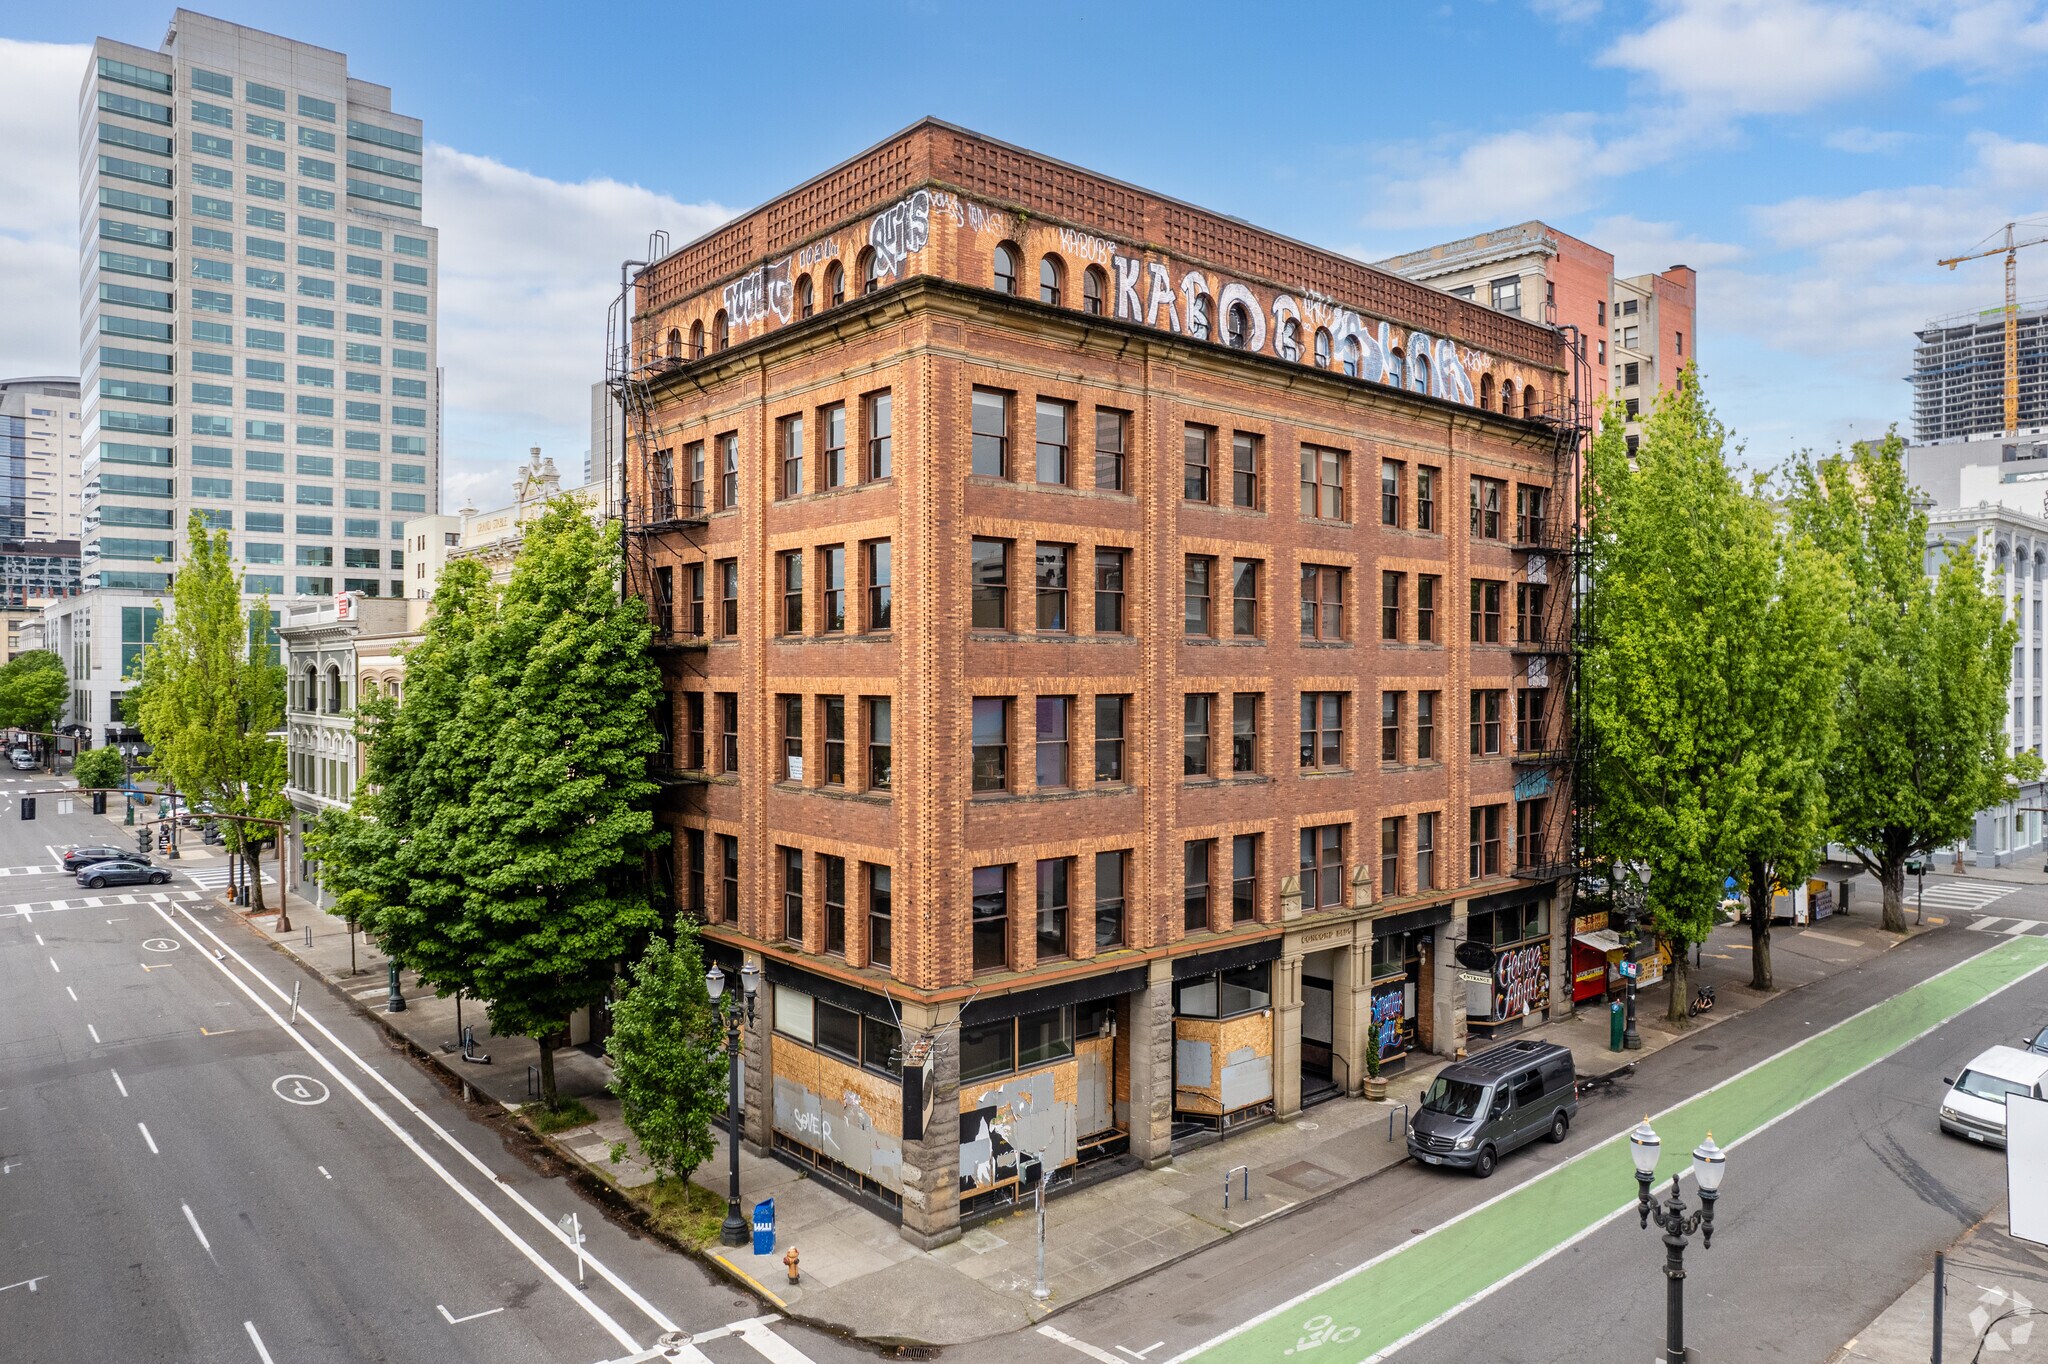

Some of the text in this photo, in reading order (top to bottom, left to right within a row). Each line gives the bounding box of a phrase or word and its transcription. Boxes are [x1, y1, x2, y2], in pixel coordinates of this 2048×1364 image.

[1059, 227, 1107, 265] KABOB
[1301, 932, 1334, 944] CONCORD
[1463, 974, 1490, 983] ENTRANCE
